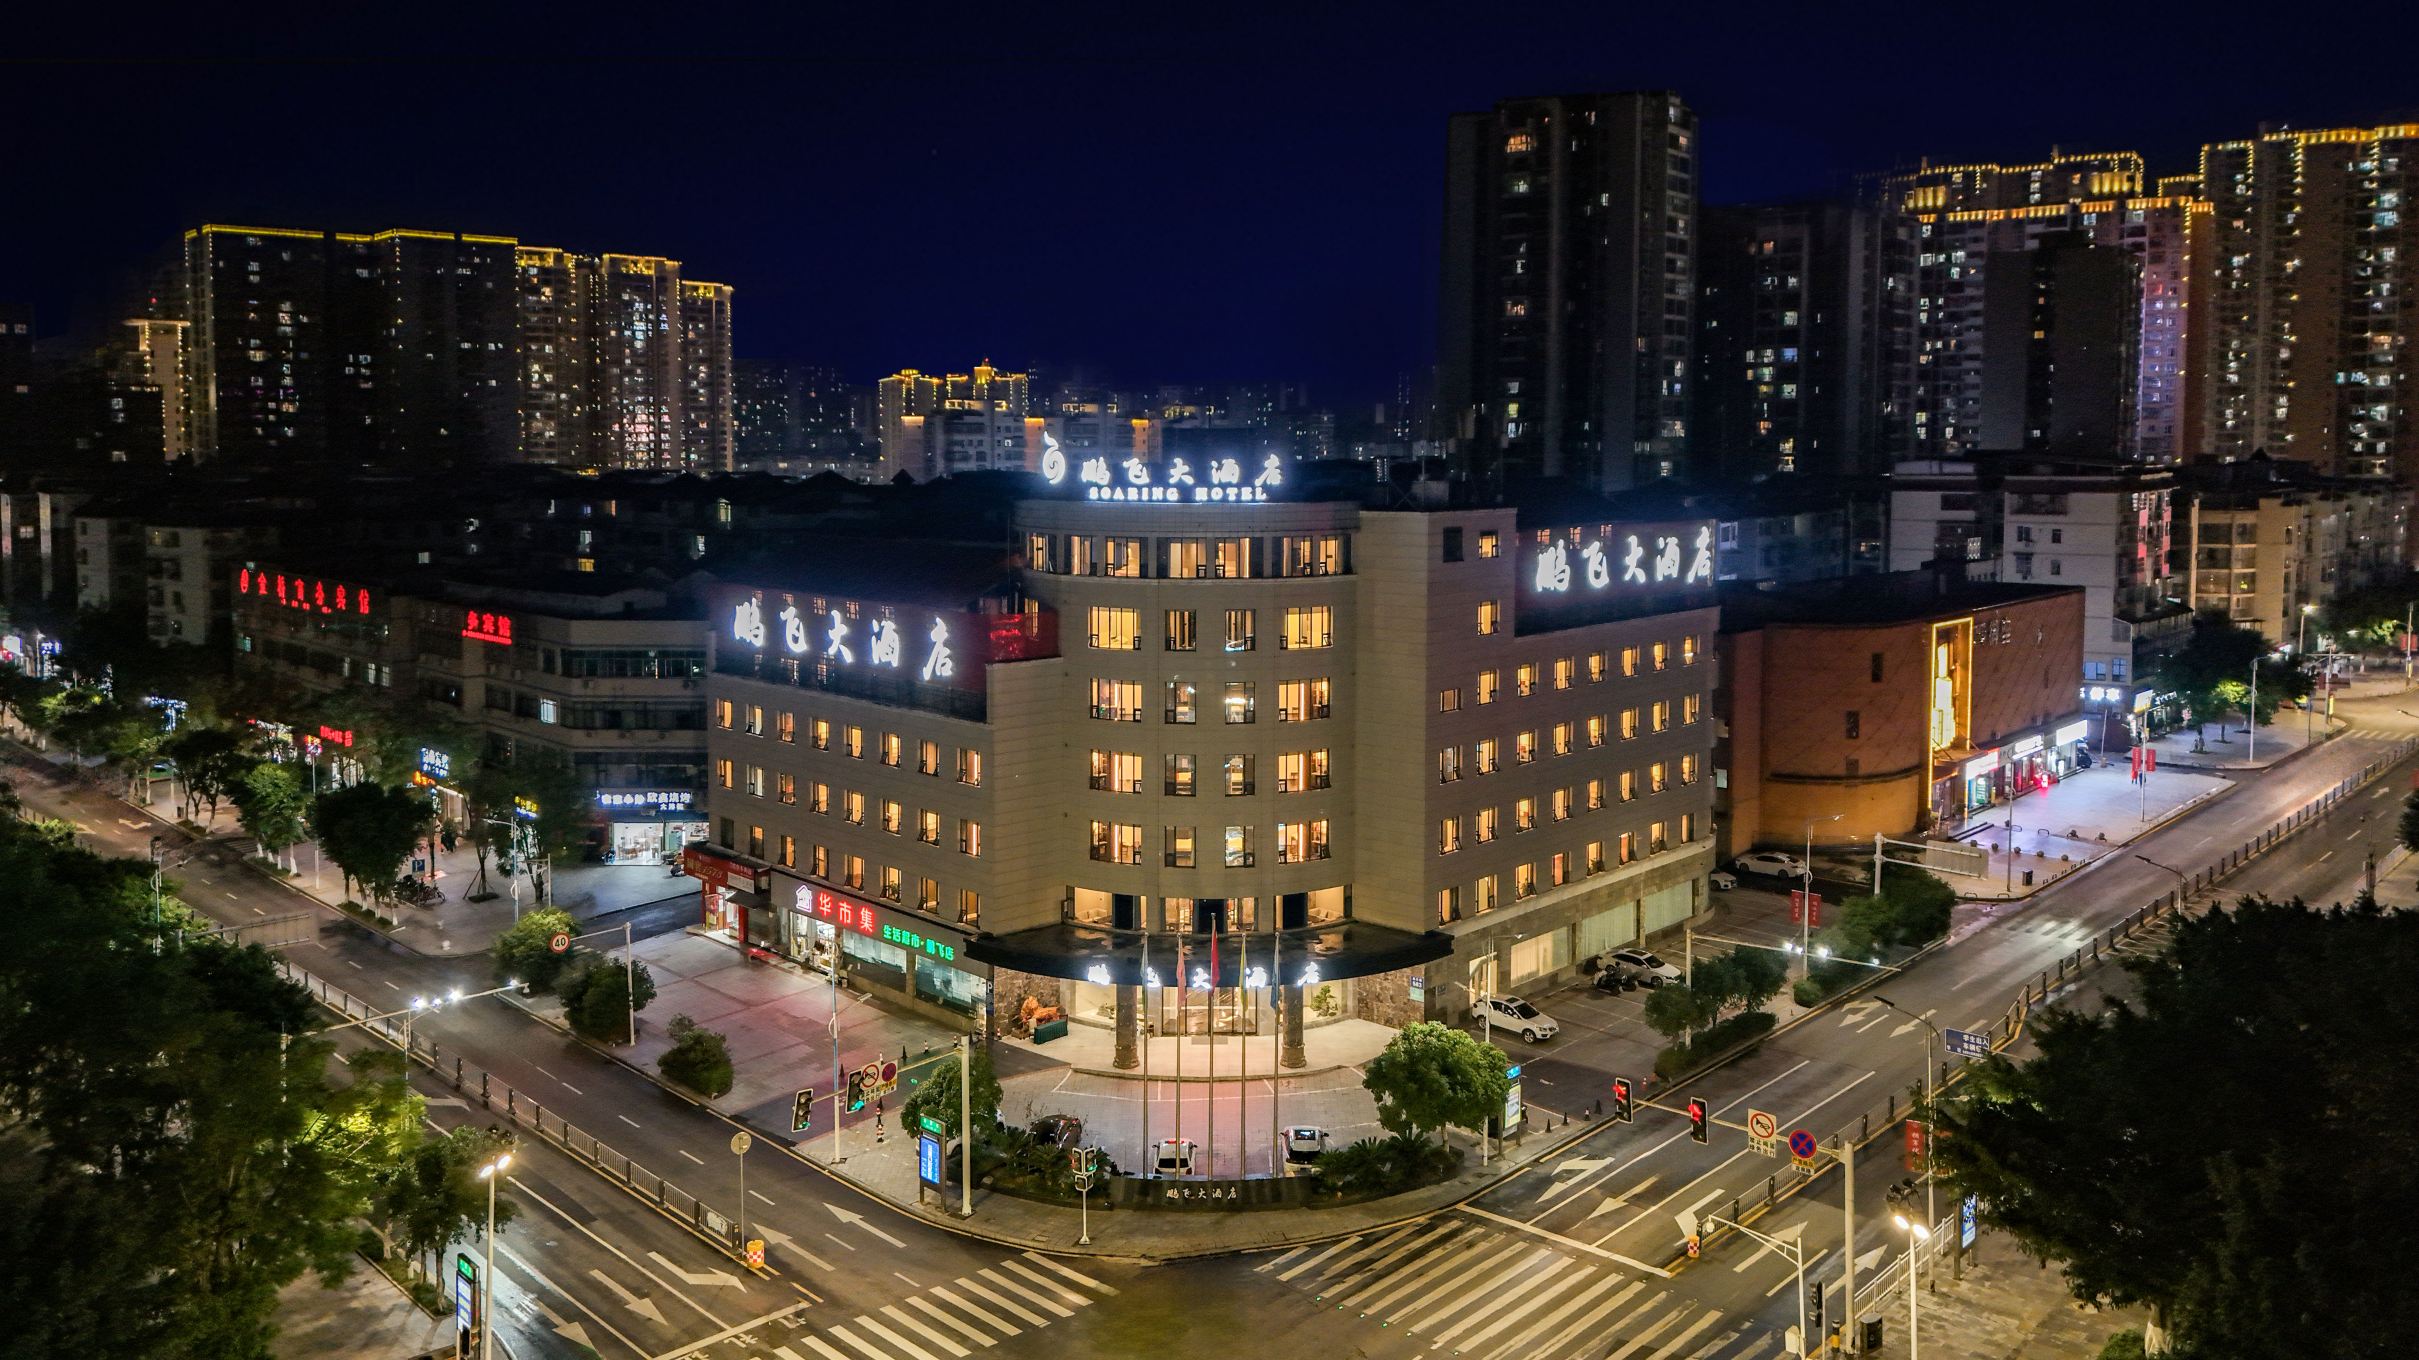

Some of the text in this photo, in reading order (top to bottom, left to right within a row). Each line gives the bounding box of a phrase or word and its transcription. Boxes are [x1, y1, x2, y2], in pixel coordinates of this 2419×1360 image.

[1081, 454, 1283, 486] 鹏飞大酒店
[1089, 487, 1267, 501] SOARING HOTEL
[1536, 526, 1712, 592] 鹏飞大酒店
[734, 598, 953, 681] 鹏飞大酒店
[819, 892, 873, 933] 华市集
[555, 937, 566, 947] 40
[1166, 1186, 1237, 1200] 鹏飞大酒店
